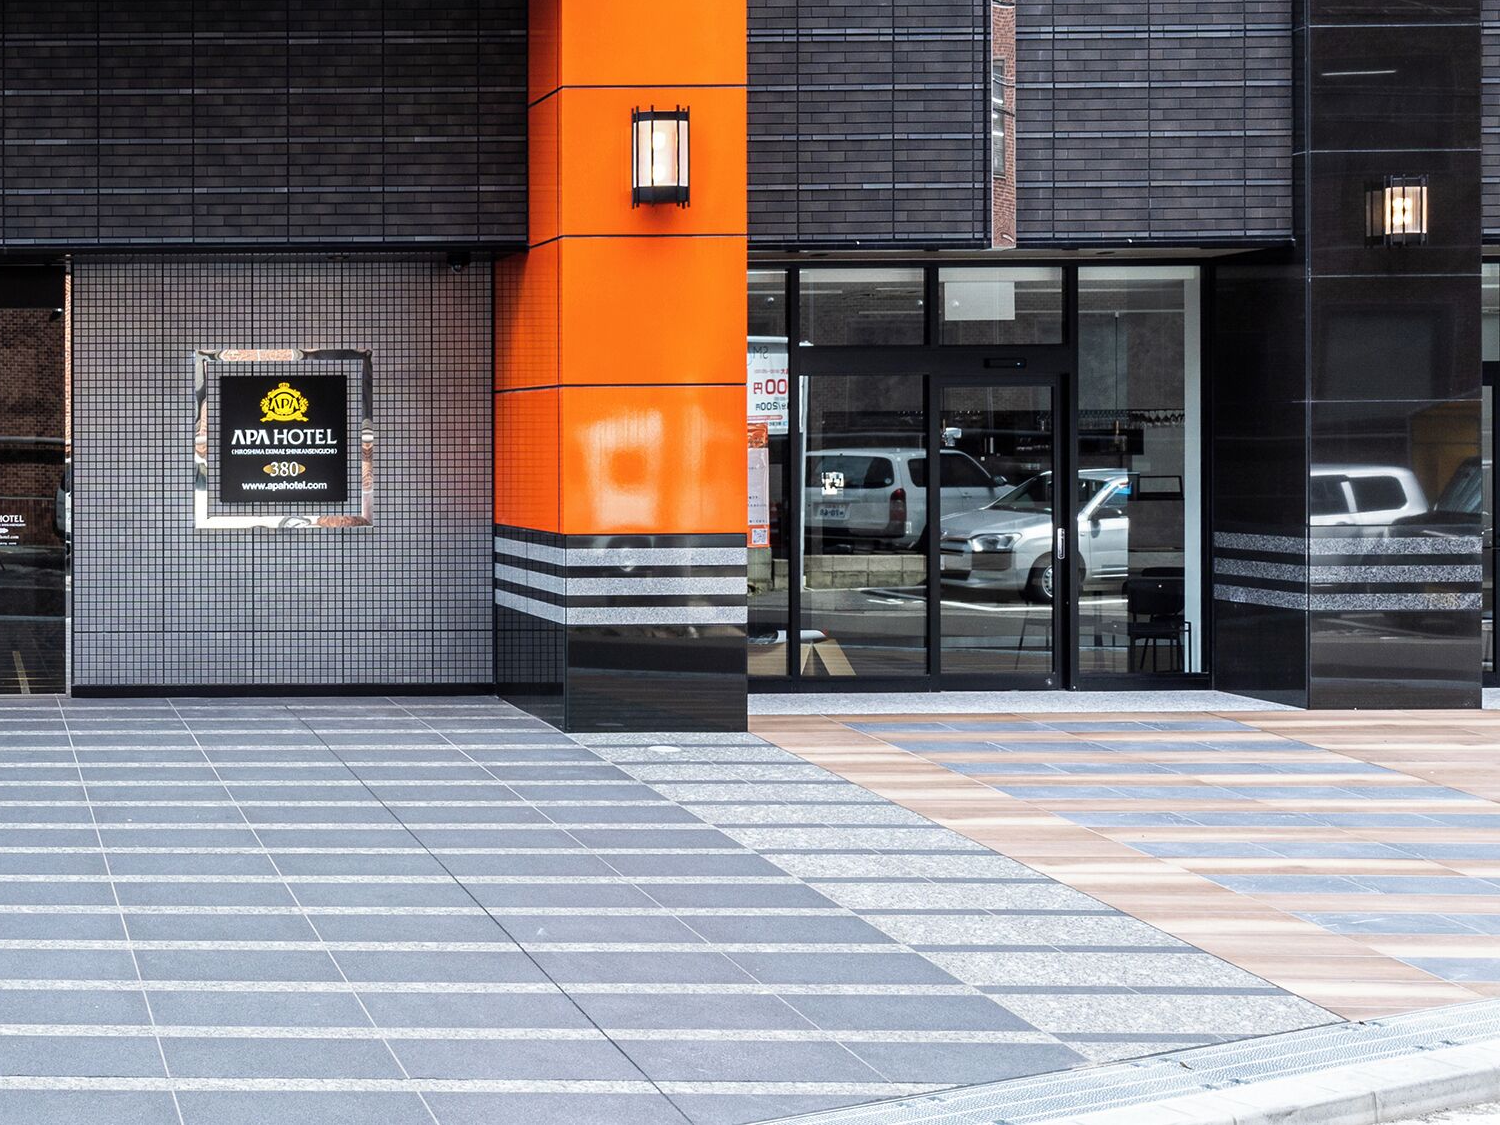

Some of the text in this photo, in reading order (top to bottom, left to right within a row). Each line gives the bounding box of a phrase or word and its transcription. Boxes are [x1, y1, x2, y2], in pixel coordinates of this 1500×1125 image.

[231, 429, 338, 445] APA HOTEL
[269, 461, 299, 477] 380
[241, 480, 328, 491] www.apahotel.com
